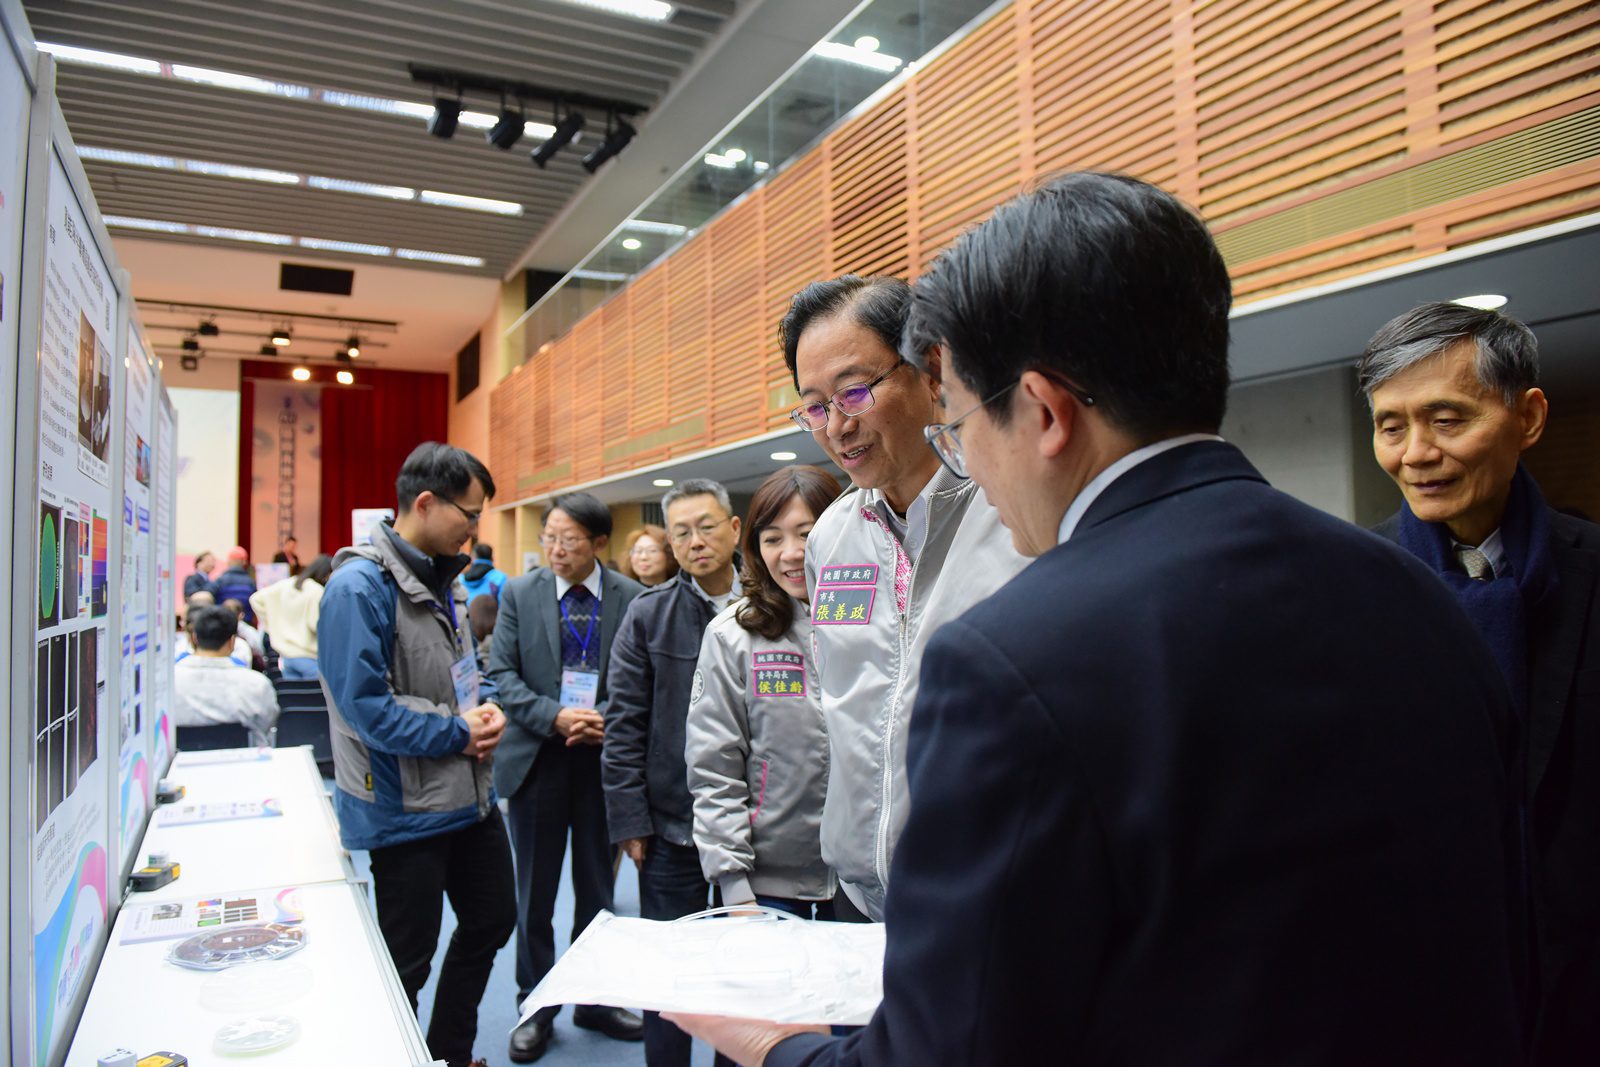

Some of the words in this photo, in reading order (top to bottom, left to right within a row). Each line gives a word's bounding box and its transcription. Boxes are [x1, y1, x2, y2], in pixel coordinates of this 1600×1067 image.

[823, 569, 871, 581] 桃園市政府
[820, 591, 835, 602] 市長
[816, 603, 865, 621] 張善政
